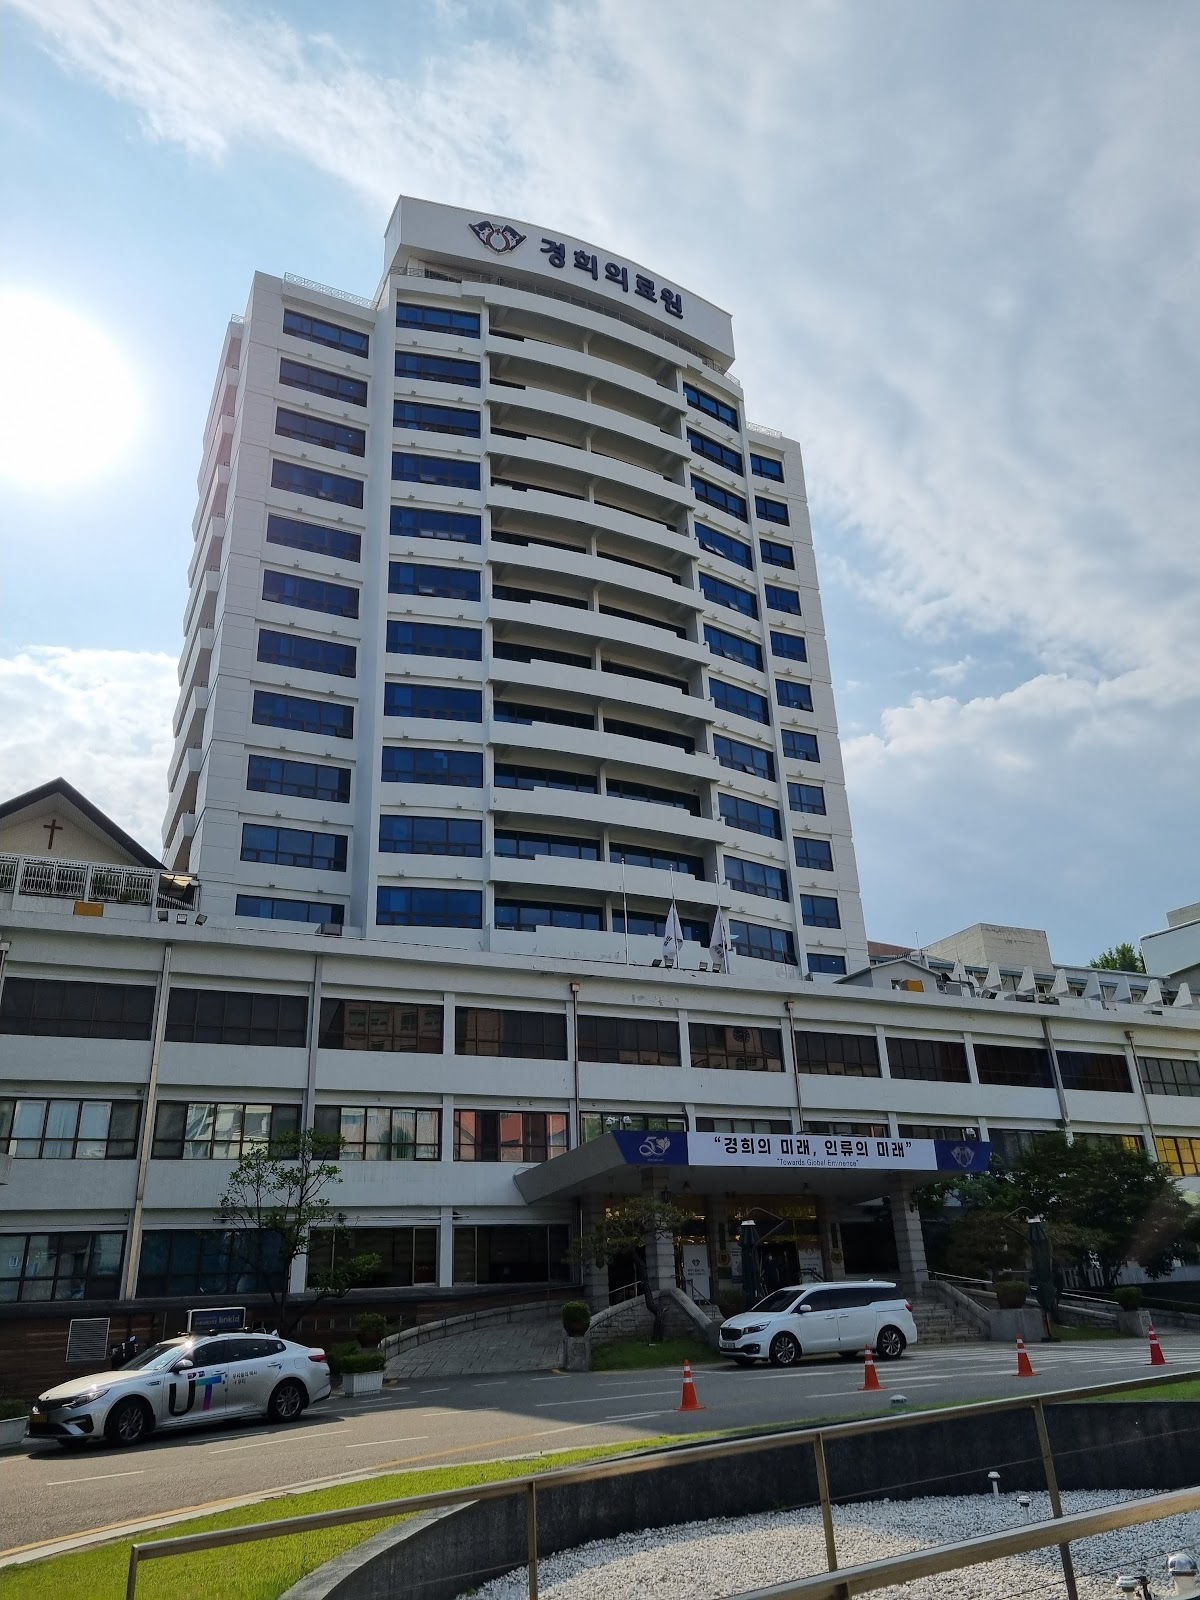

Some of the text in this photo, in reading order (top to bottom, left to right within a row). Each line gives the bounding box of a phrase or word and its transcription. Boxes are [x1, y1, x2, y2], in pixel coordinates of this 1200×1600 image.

[540, 238, 684, 320] 경희의료원
[714, 1136, 912, 1158] “경희의 미래, 인류의 미래”
[806, 1158, 826, 1167] Global
[169, 1375, 222, 1417] UT
